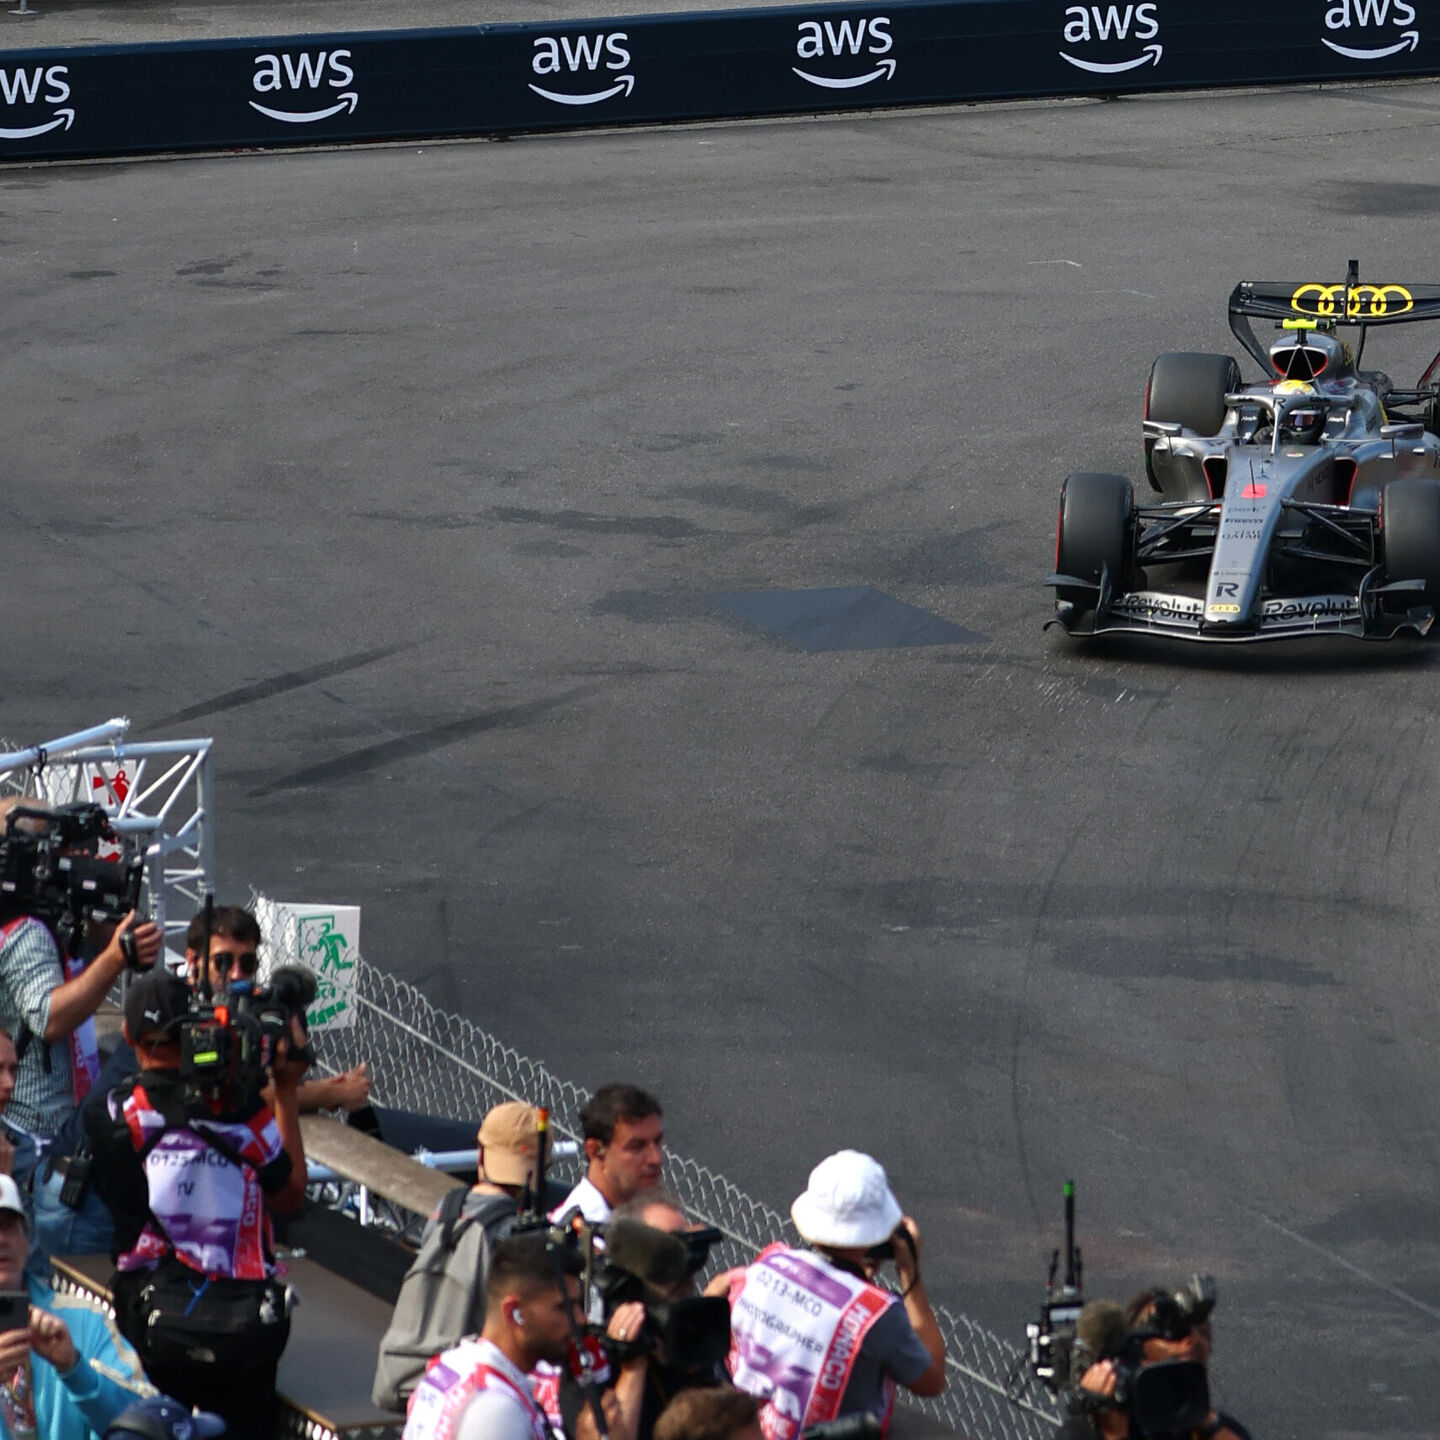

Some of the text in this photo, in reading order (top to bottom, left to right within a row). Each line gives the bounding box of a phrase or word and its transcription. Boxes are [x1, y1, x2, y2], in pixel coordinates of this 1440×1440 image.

[797, 17, 893, 58] aws
[1065, 3, 1159, 43] aws
[254, 50, 354, 92] aws
[533, 33, 631, 74] aws
[0, 66, 71, 104] ws
[1216, 582, 1240, 597] R
[820, 1302, 873, 1391] MONACO
